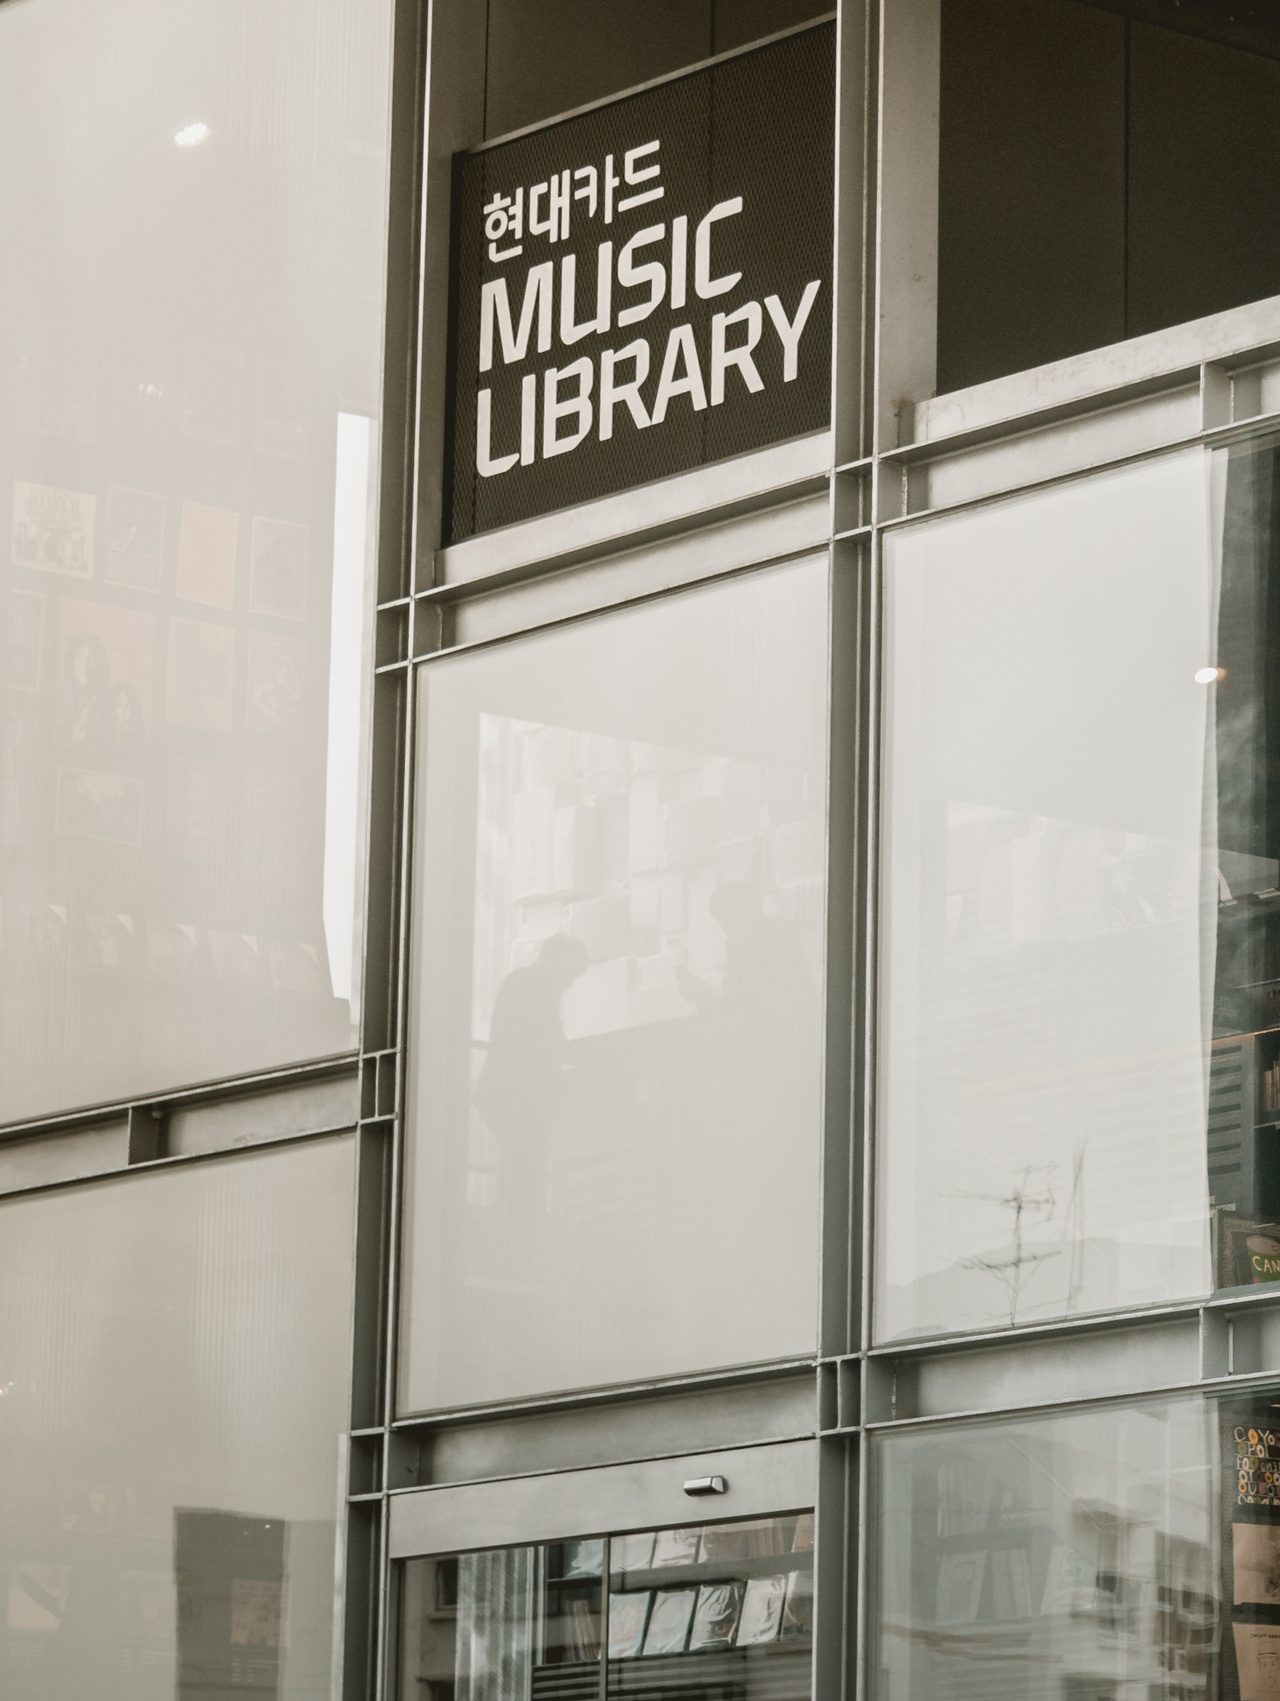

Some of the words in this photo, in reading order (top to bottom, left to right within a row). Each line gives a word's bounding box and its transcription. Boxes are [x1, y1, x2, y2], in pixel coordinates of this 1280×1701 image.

[479, 196, 743, 373] MUSIC
[483, 139, 665, 263] 현대카드
[476, 279, 822, 478] LIBRARY
